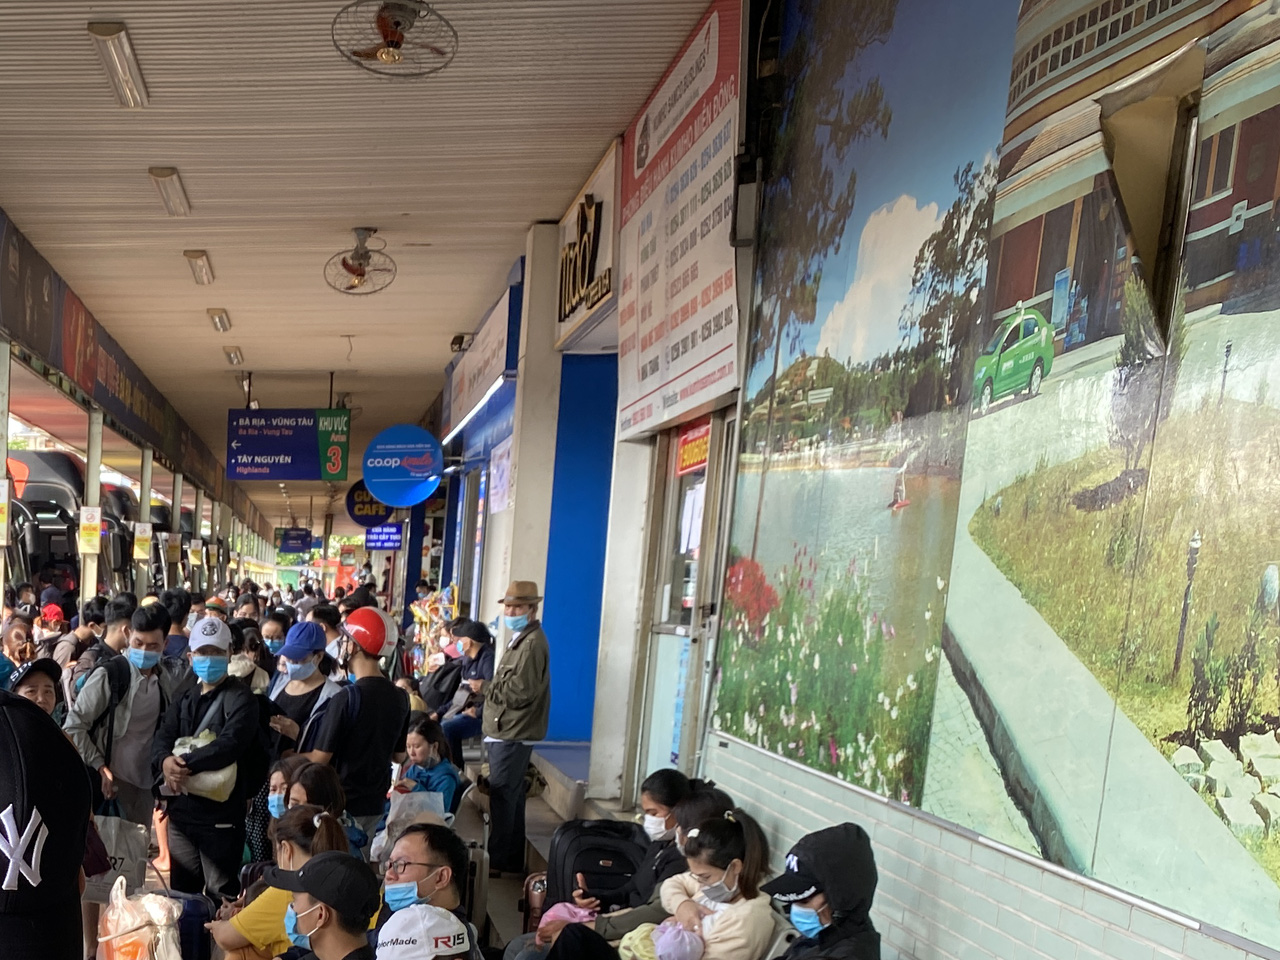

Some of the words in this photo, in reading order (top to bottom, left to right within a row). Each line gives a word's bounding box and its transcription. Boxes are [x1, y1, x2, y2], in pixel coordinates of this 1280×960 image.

[237, 454, 253, 463] TÂY
[254, 454, 291, 463] NGUYÊN
[326, 446, 342, 474] 3
[367, 457, 400, 468] co.op
[433, 933, 465, 949] R15
